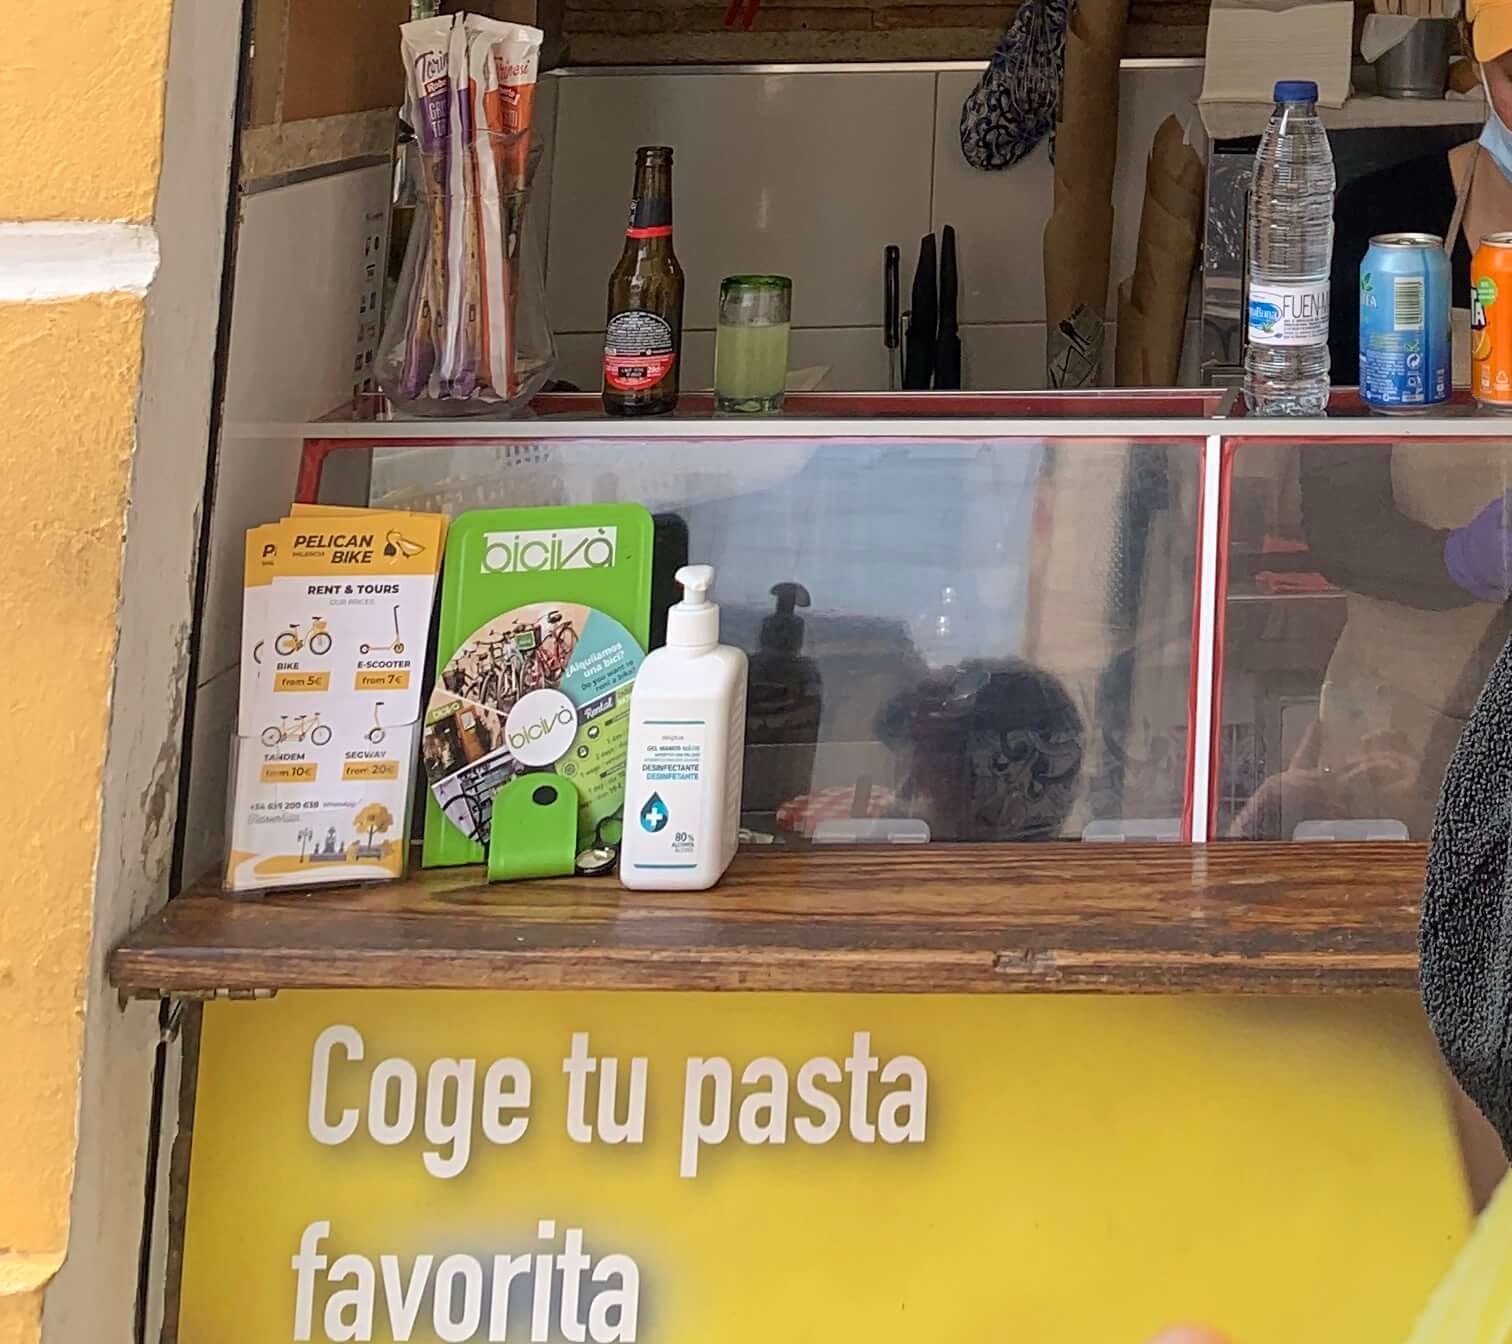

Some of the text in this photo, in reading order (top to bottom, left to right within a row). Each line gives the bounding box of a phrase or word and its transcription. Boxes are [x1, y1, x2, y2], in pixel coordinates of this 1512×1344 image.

[294, 535, 375, 548] PELICAN
[330, 550, 374, 564] BIKE
[307, 584, 400, 595] RENT & TOURS
[276, 662, 299, 671] BIKE
[357, 660, 411, 669] E-SCOOTER
[282, 678, 305, 686] from
[362, 676, 385, 685] from
[264, 753, 306, 761] TANDEM
[345, 751, 387, 759] SEGWAY
[642, 764, 699, 772] DESINFECTANTE
[306, 1024, 929, 1180] Coge tu pasta
[291, 1218, 641, 1344] favorita
